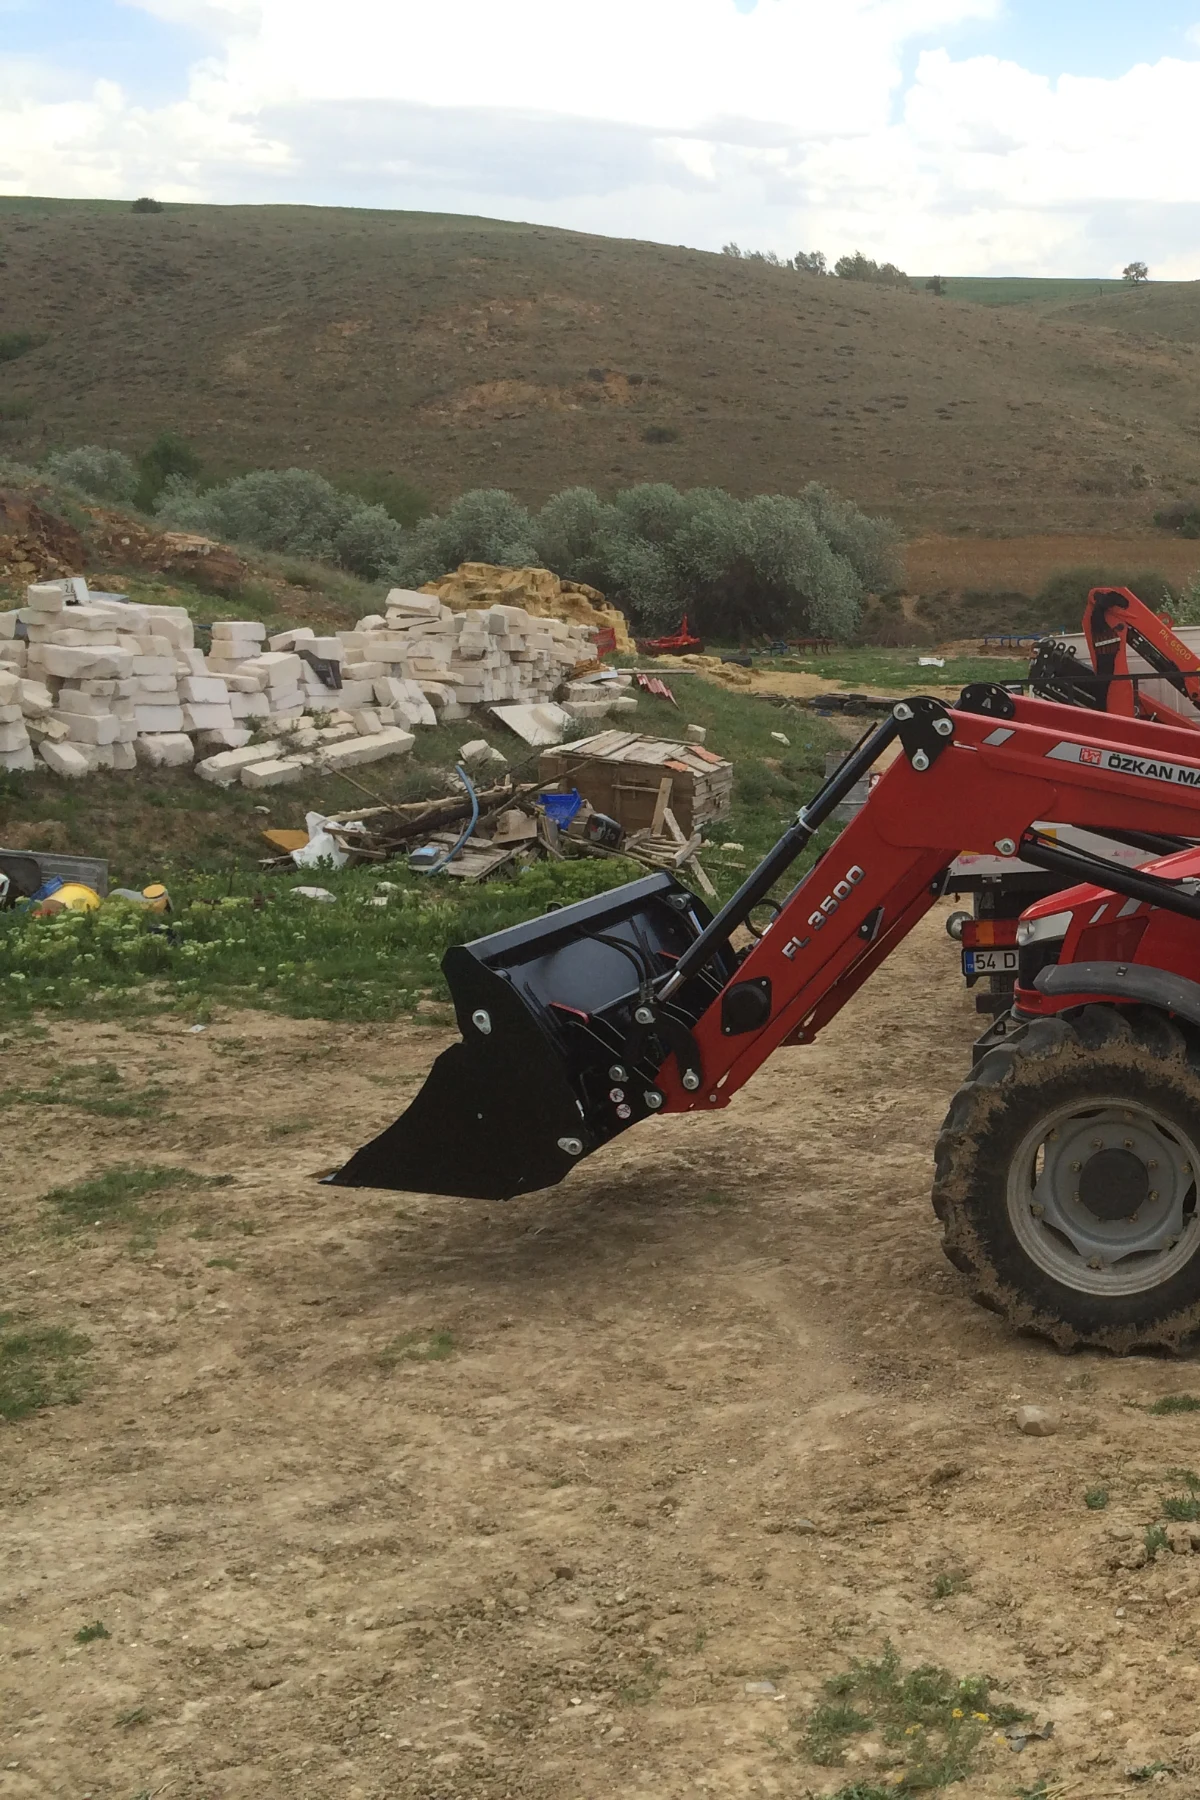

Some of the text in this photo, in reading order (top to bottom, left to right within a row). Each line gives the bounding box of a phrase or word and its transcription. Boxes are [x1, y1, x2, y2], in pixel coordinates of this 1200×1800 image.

[1159, 628, 1192, 661] PK 6500
[1107, 753, 1173, 780] ÖZKAN
[781, 864, 866, 961] FL 3500
[975, 952, 1016, 970] 54 D
